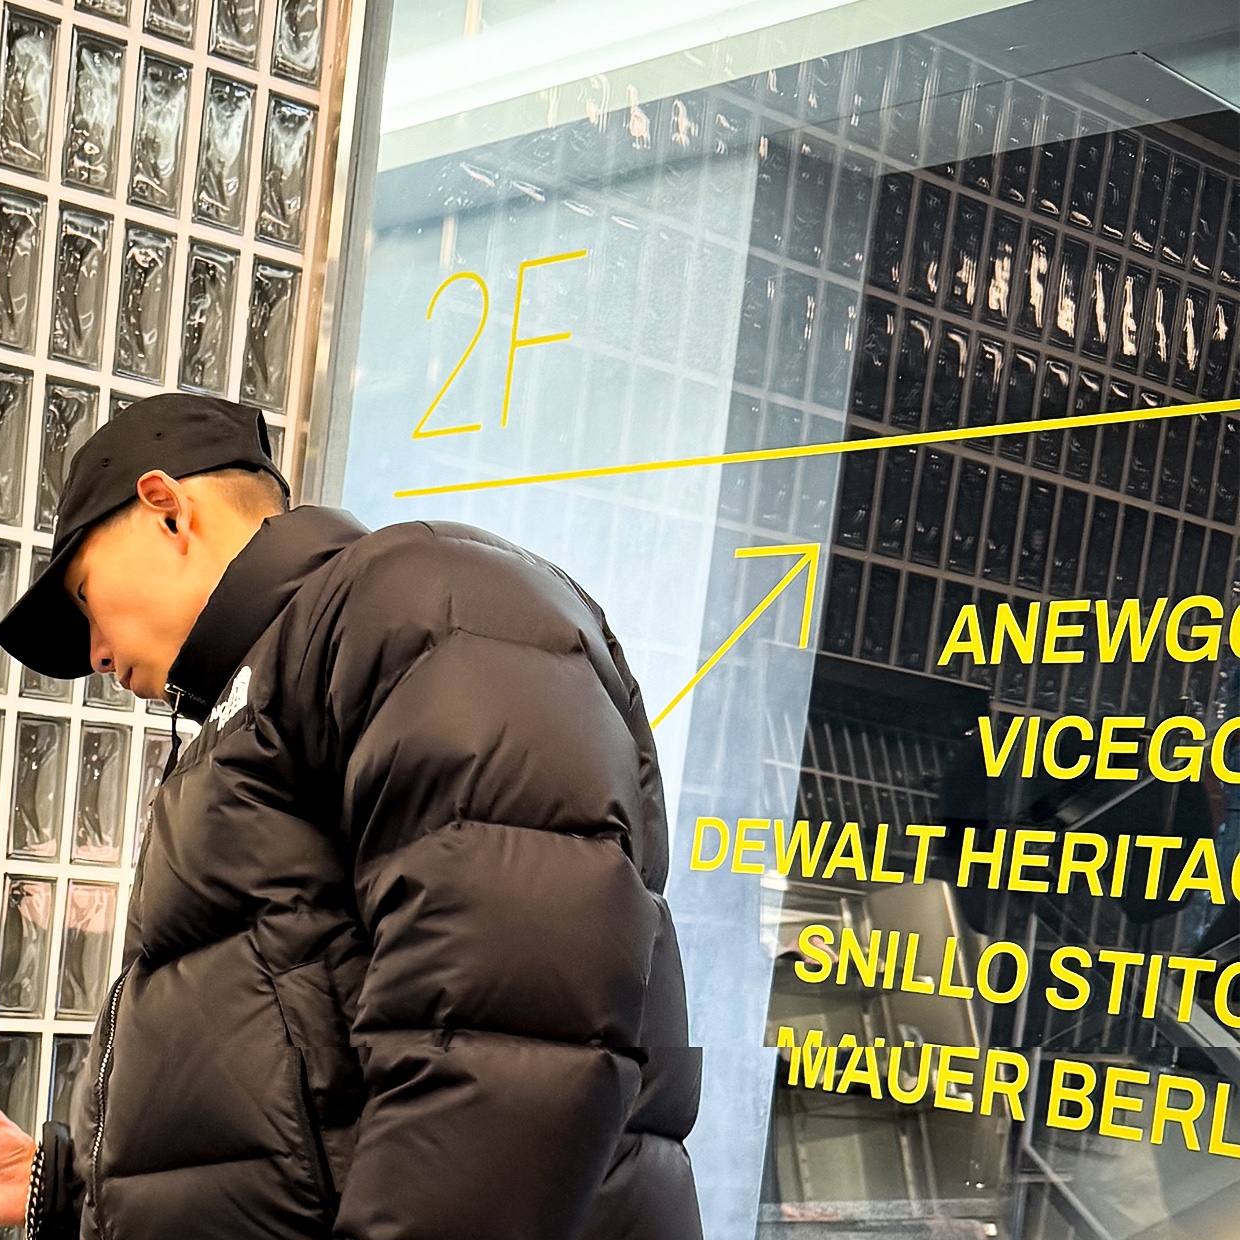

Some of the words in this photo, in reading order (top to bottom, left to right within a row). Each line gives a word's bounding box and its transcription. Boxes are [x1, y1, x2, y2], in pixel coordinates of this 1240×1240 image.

[411, 248, 588, 440] 2F
[937, 595, 1240, 667] ANEWG
[689, 816, 947, 885] DEWALT
[956, 827, 1240, 906] HERITA
[794, 924, 1029, 1005] SNILLO
[775, 1026, 1029, 1122] MAUER
